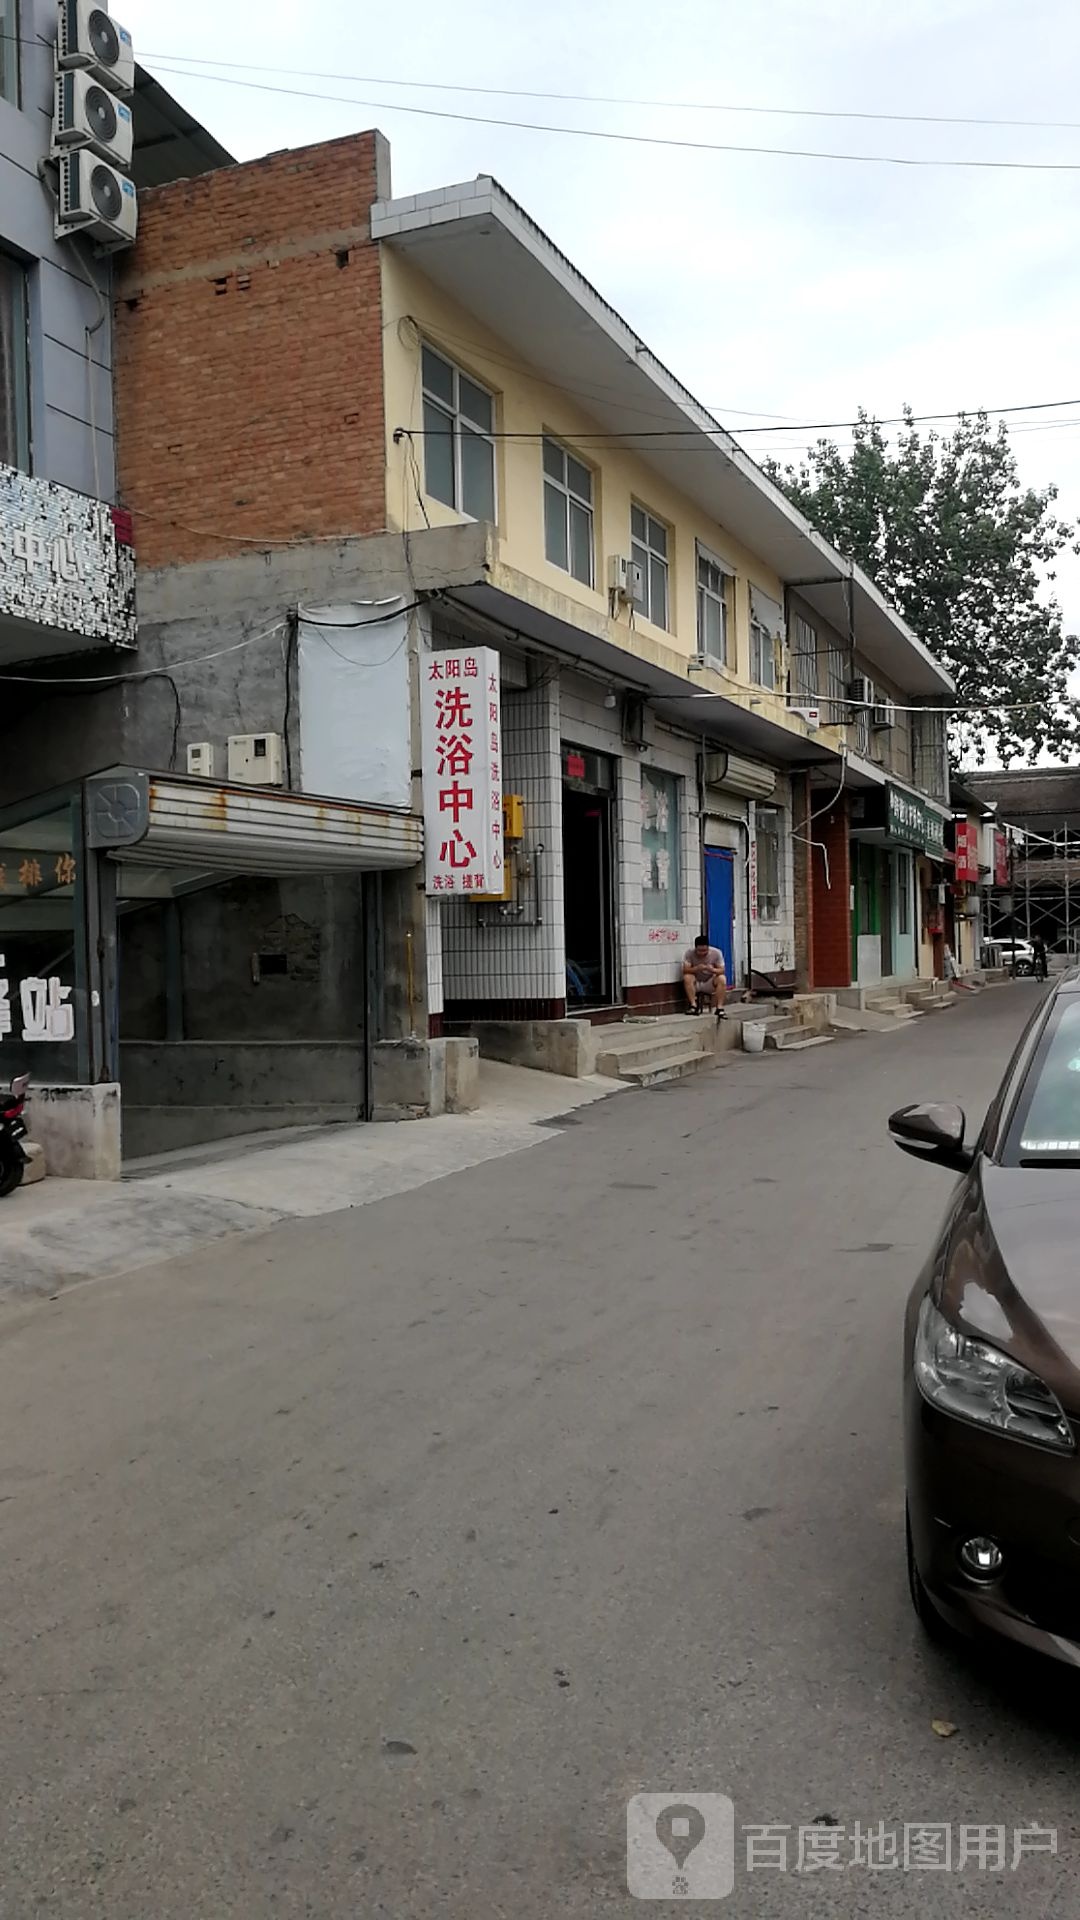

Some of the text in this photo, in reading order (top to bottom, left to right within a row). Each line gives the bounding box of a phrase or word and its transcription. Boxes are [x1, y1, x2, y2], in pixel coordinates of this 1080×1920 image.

[0, 525, 87, 583] 中心
[428, 657, 477, 681] 太阳岛
[434, 686, 477, 868] 洗浴中心
[488, 672, 502, 869] 太阳岛洗浴中心
[432, 874, 455, 890] 洗浴
